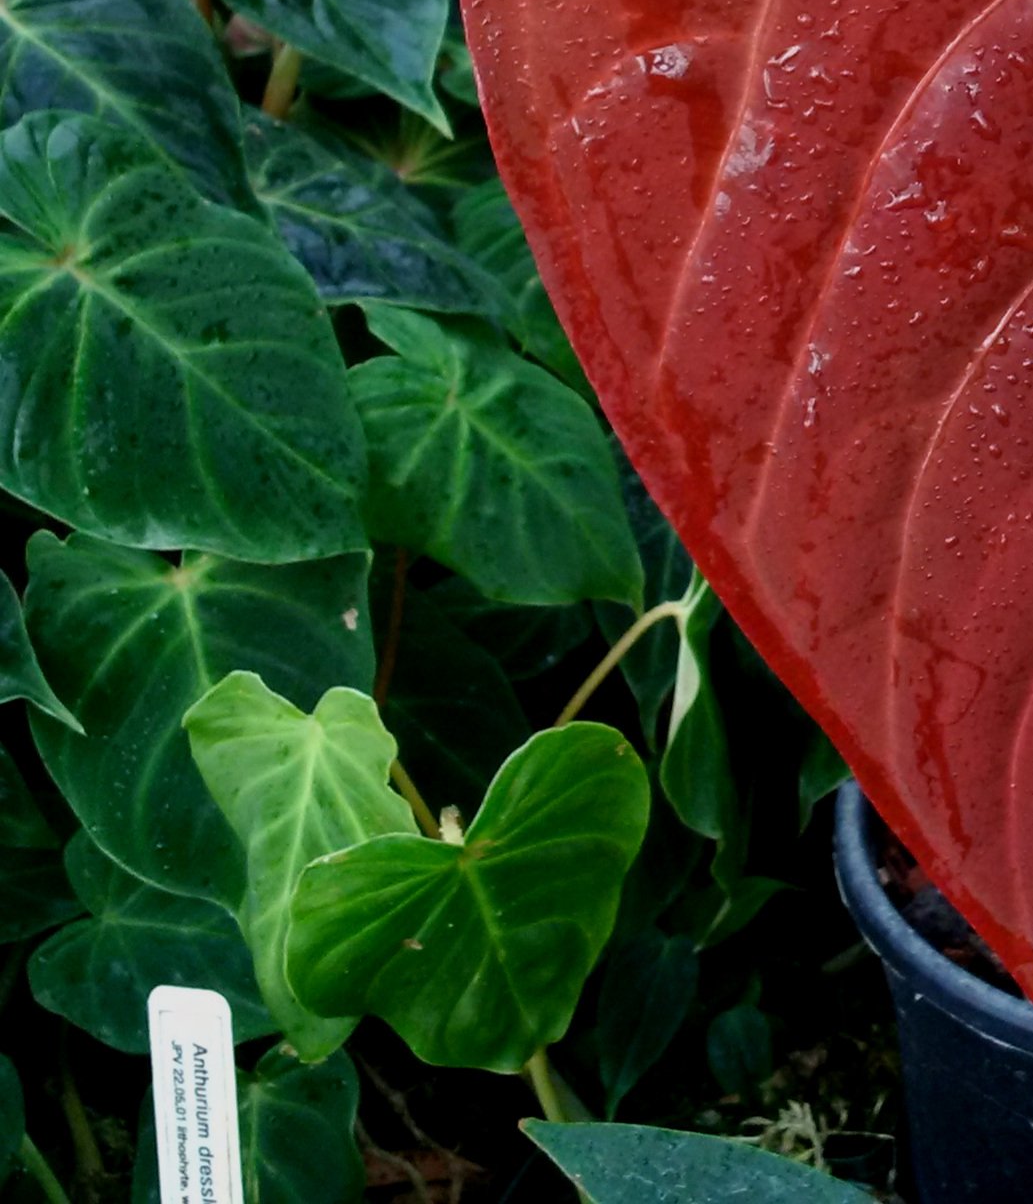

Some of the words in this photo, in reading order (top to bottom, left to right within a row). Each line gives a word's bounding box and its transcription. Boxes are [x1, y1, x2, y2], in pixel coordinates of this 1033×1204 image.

[171, 1040, 184, 1065] JPV
[193, 1042, 211, 1139] Anthurium
[198, 1146, 217, 1204] dressl
